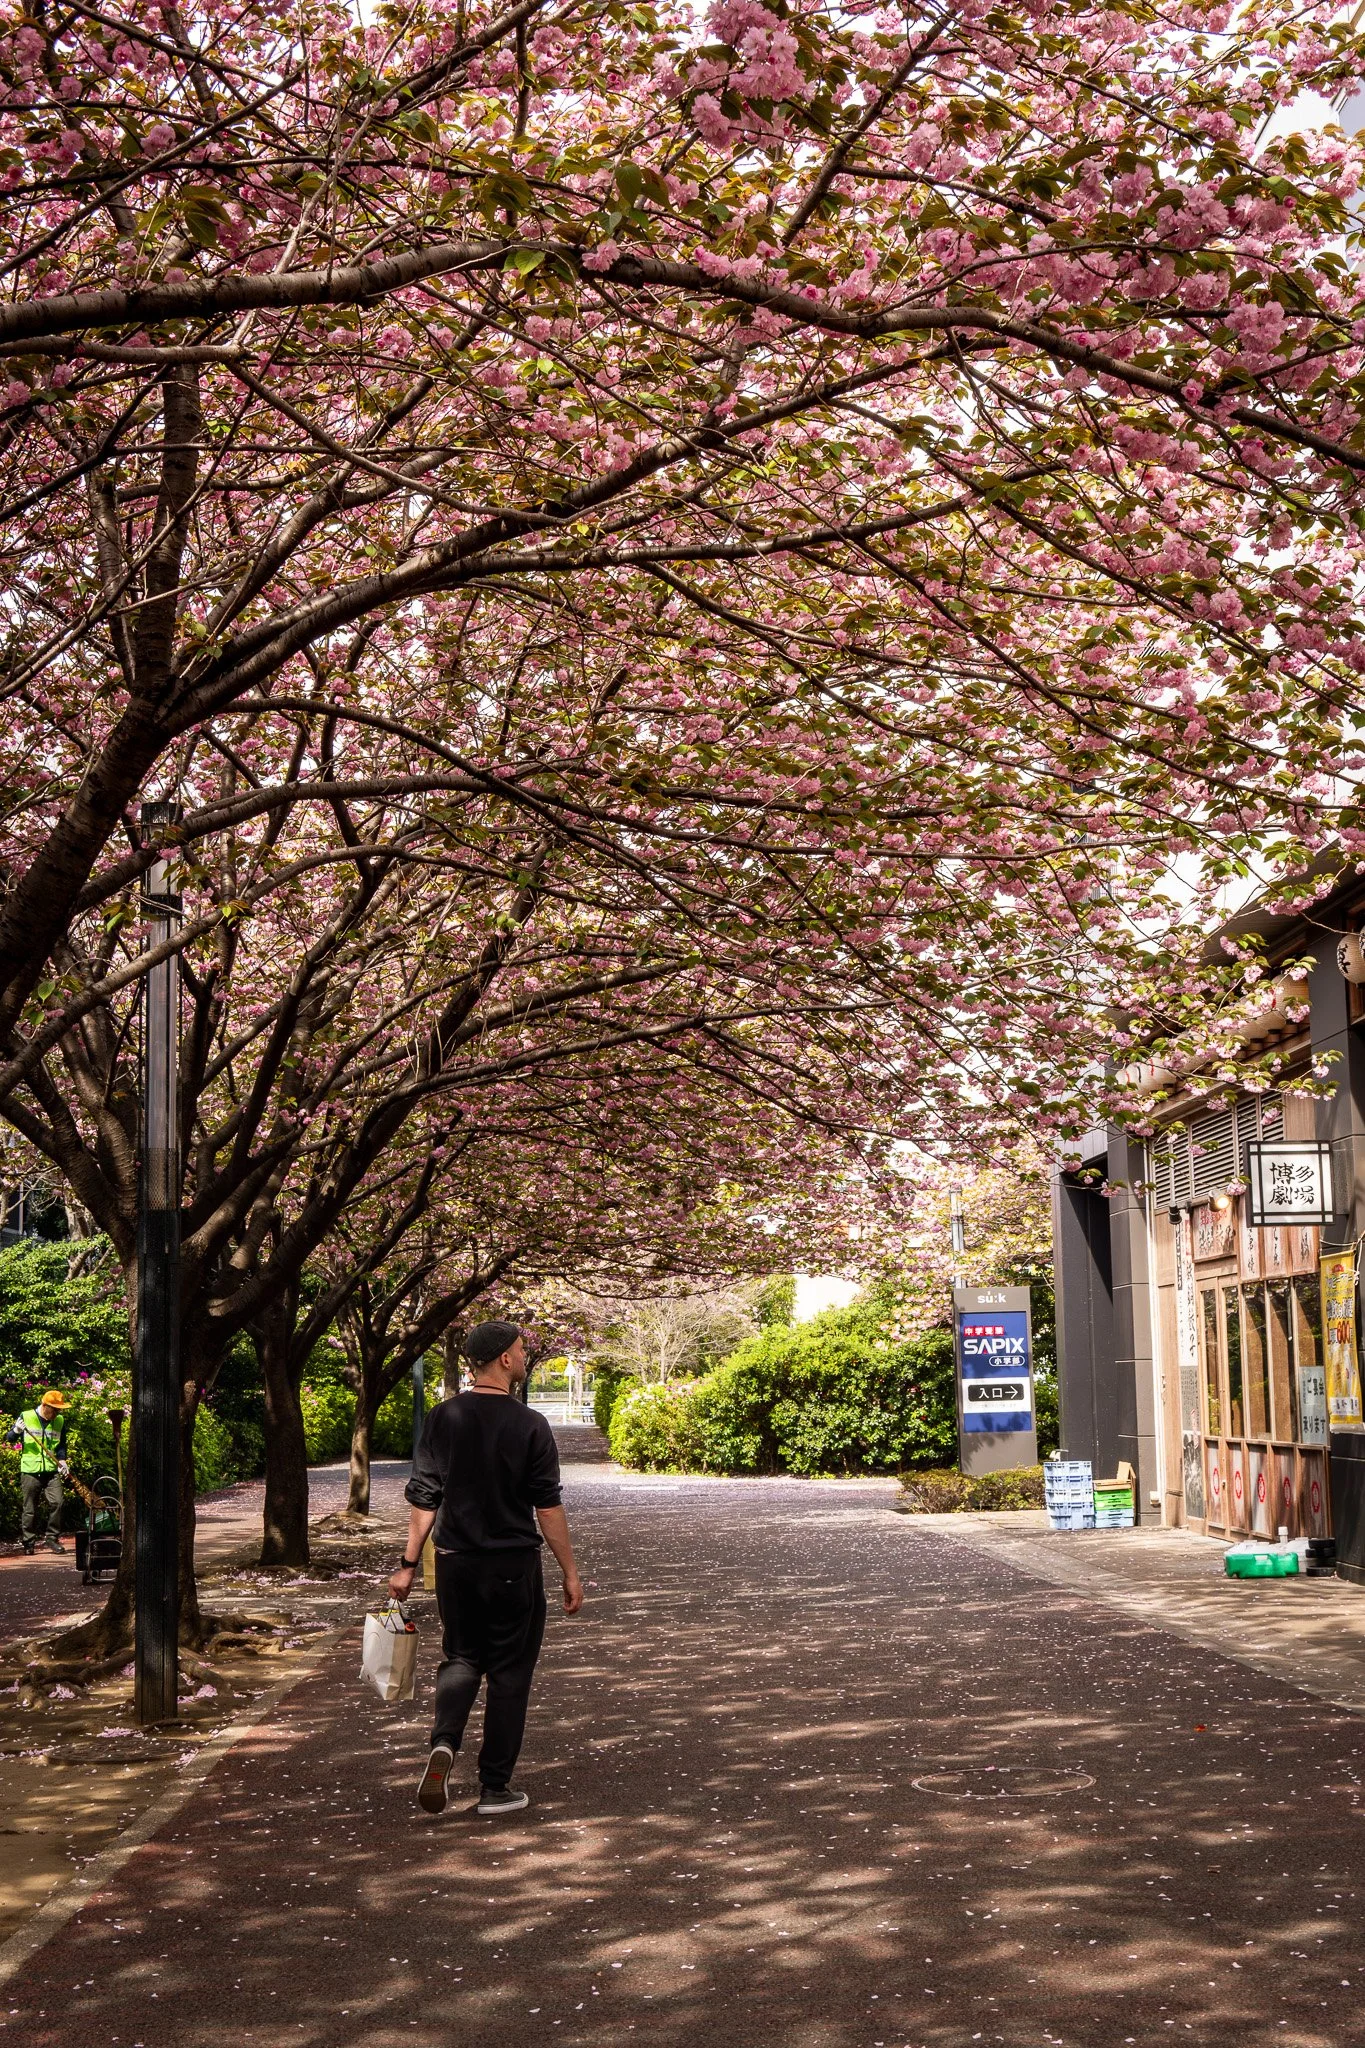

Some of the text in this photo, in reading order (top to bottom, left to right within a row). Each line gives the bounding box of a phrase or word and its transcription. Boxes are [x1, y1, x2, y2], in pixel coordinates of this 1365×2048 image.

[1269, 1162, 1315, 1184] 博多
[1269, 1185, 1315, 1205] 劇場
[964, 1326, 1004, 1336] 中学受験
[963, 1337, 1025, 1355] SAPIX
[994, 1357, 1021, 1365] 小学部
[978, 1387, 1003, 1399] 入口
